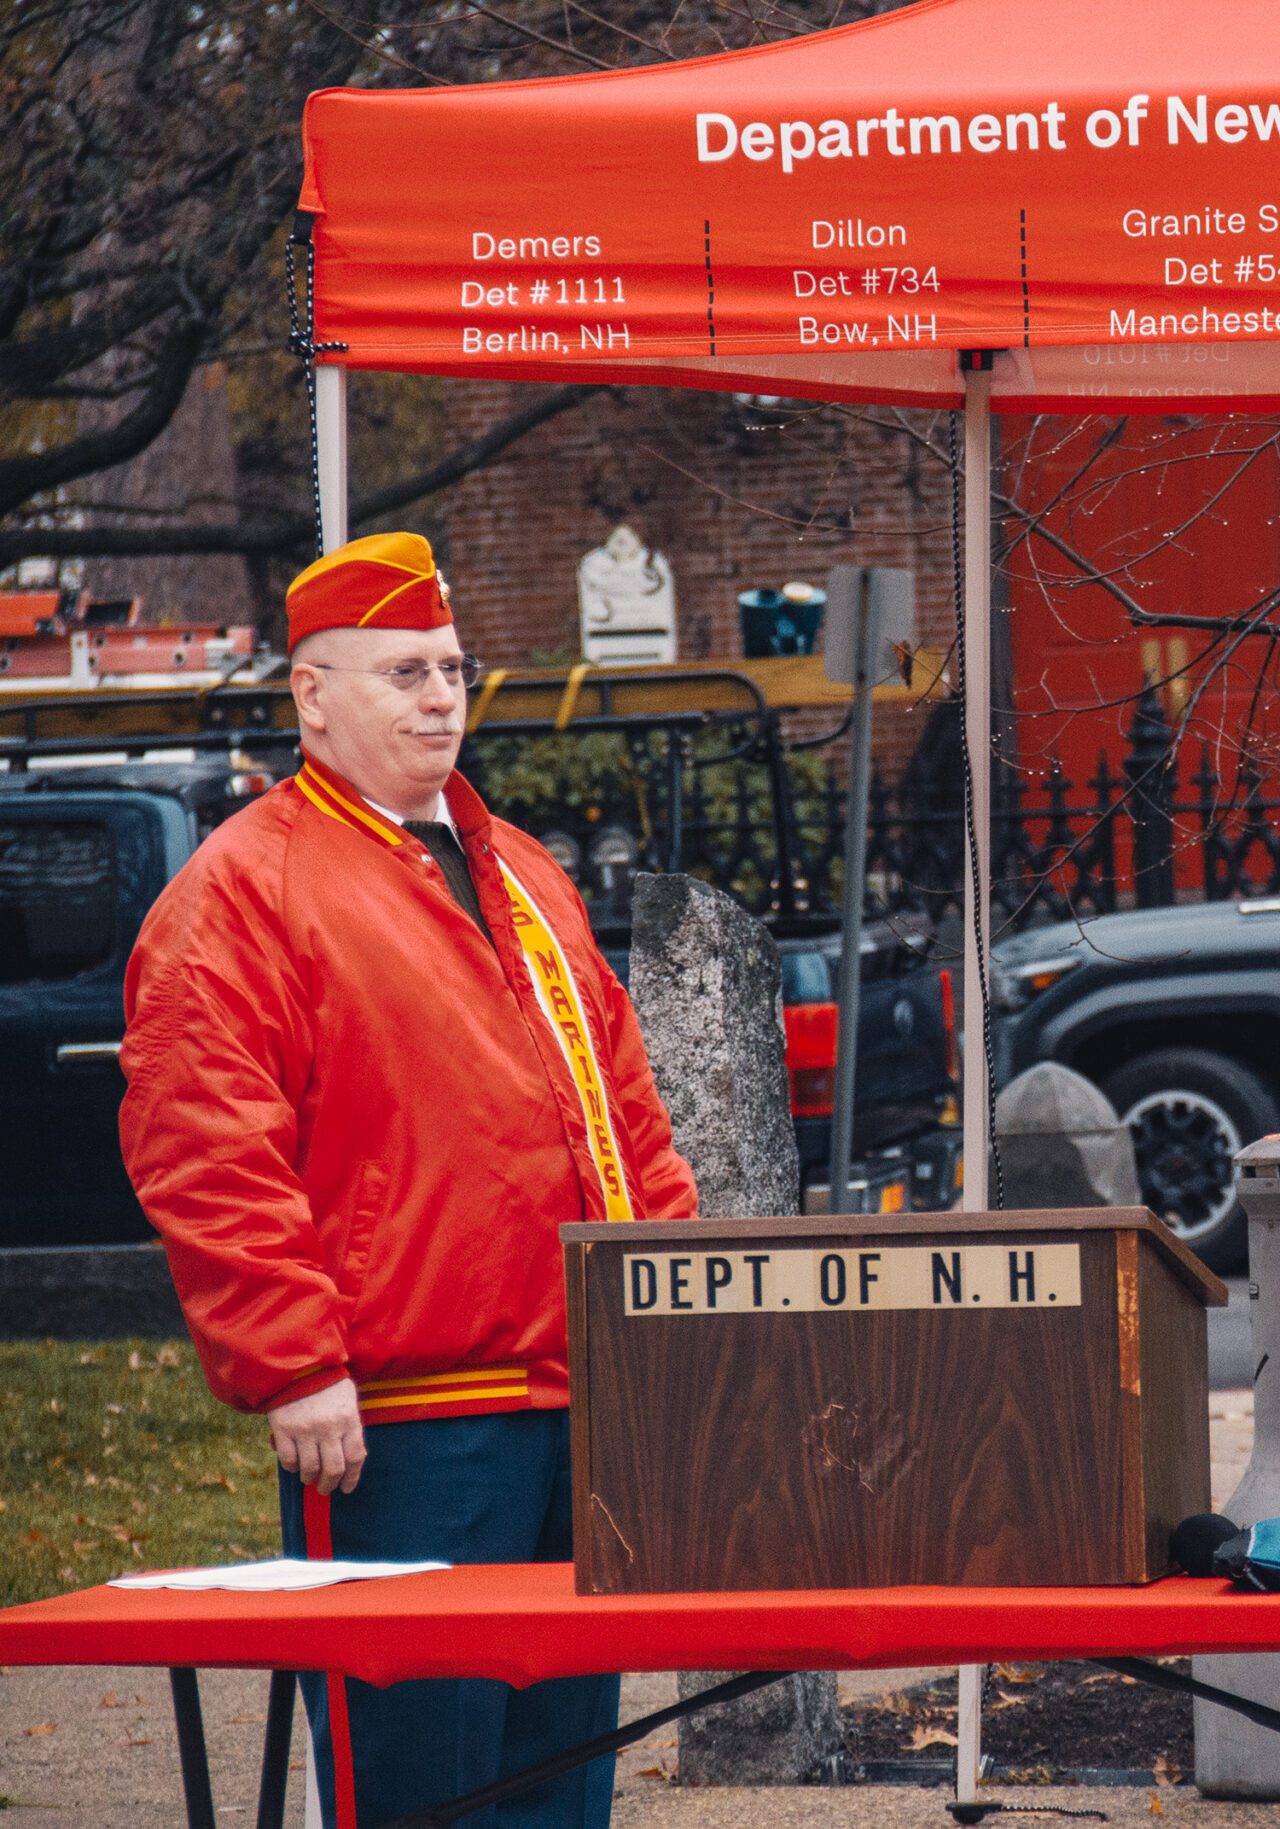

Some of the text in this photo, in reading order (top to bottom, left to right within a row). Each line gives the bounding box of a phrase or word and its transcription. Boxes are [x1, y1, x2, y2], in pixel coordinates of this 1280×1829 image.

[696, 101, 1067, 174] Department
[1085, 93, 1150, 149] of
[812, 218, 906, 249] Dillon
[1122, 208, 1246, 237] Granite
[472, 232, 601, 260] Demers
[793, 266, 940, 298] Det #734
[1164, 257, 1223, 285] Det
[460, 276, 626, 308] Det #1111
[462, 323, 630, 354] Berlin, NH
[798, 313, 937, 346] Bow, NH
[534, 949, 620, 1198] MARINES
[630, 1250, 1057, 1311] DEPT. OF N. H.
